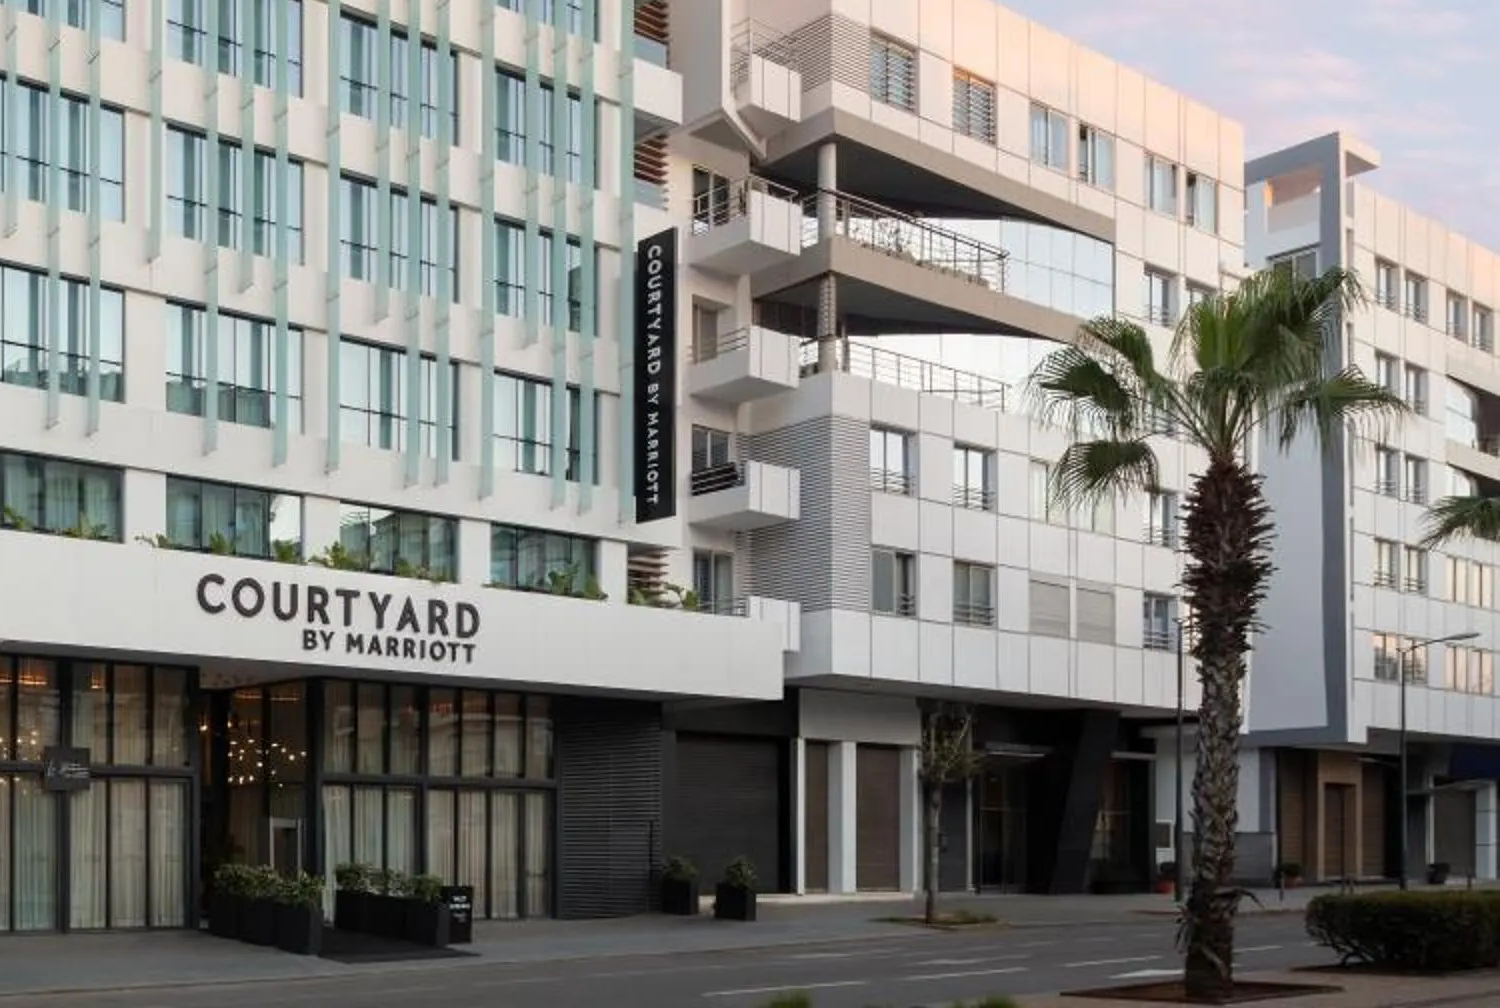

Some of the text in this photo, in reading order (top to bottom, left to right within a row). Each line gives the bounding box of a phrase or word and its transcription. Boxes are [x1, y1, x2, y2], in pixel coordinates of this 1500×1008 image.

[646, 244, 662, 504] COURTYARD BY MARRIOTT
[197, 573, 480, 639] COURTYARD
[302, 628, 476, 664] BY MARRIOTT
